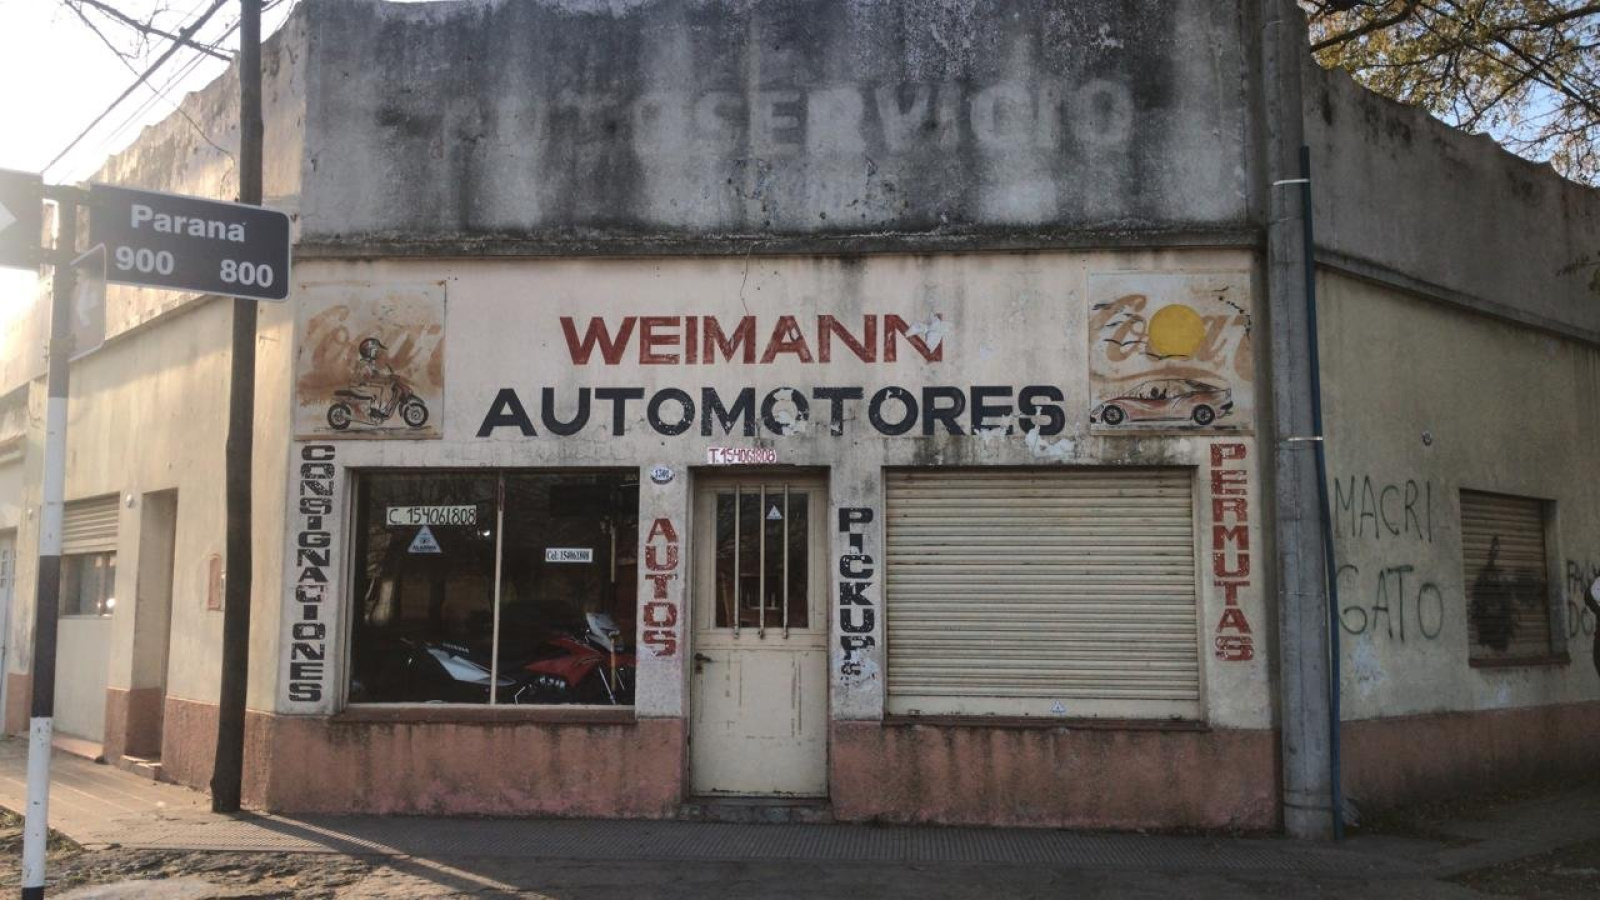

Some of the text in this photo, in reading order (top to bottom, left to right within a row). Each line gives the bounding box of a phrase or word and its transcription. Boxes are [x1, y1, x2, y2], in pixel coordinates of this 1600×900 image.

[115, 245, 274, 289] 900 800
[560, 314, 943, 365] WEIMANN
[476, 385, 1066, 437] AUTOMOTORES
[407, 507, 477, 525] 154061808
[1333, 474, 1433, 544] MACRI
[288, 444, 337, 703] CONSIGNACIONES
[643, 517, 680, 658] AUTOS
[1209, 443, 1255, 662] PERMUTAS
[1336, 564, 1445, 643] GATO
